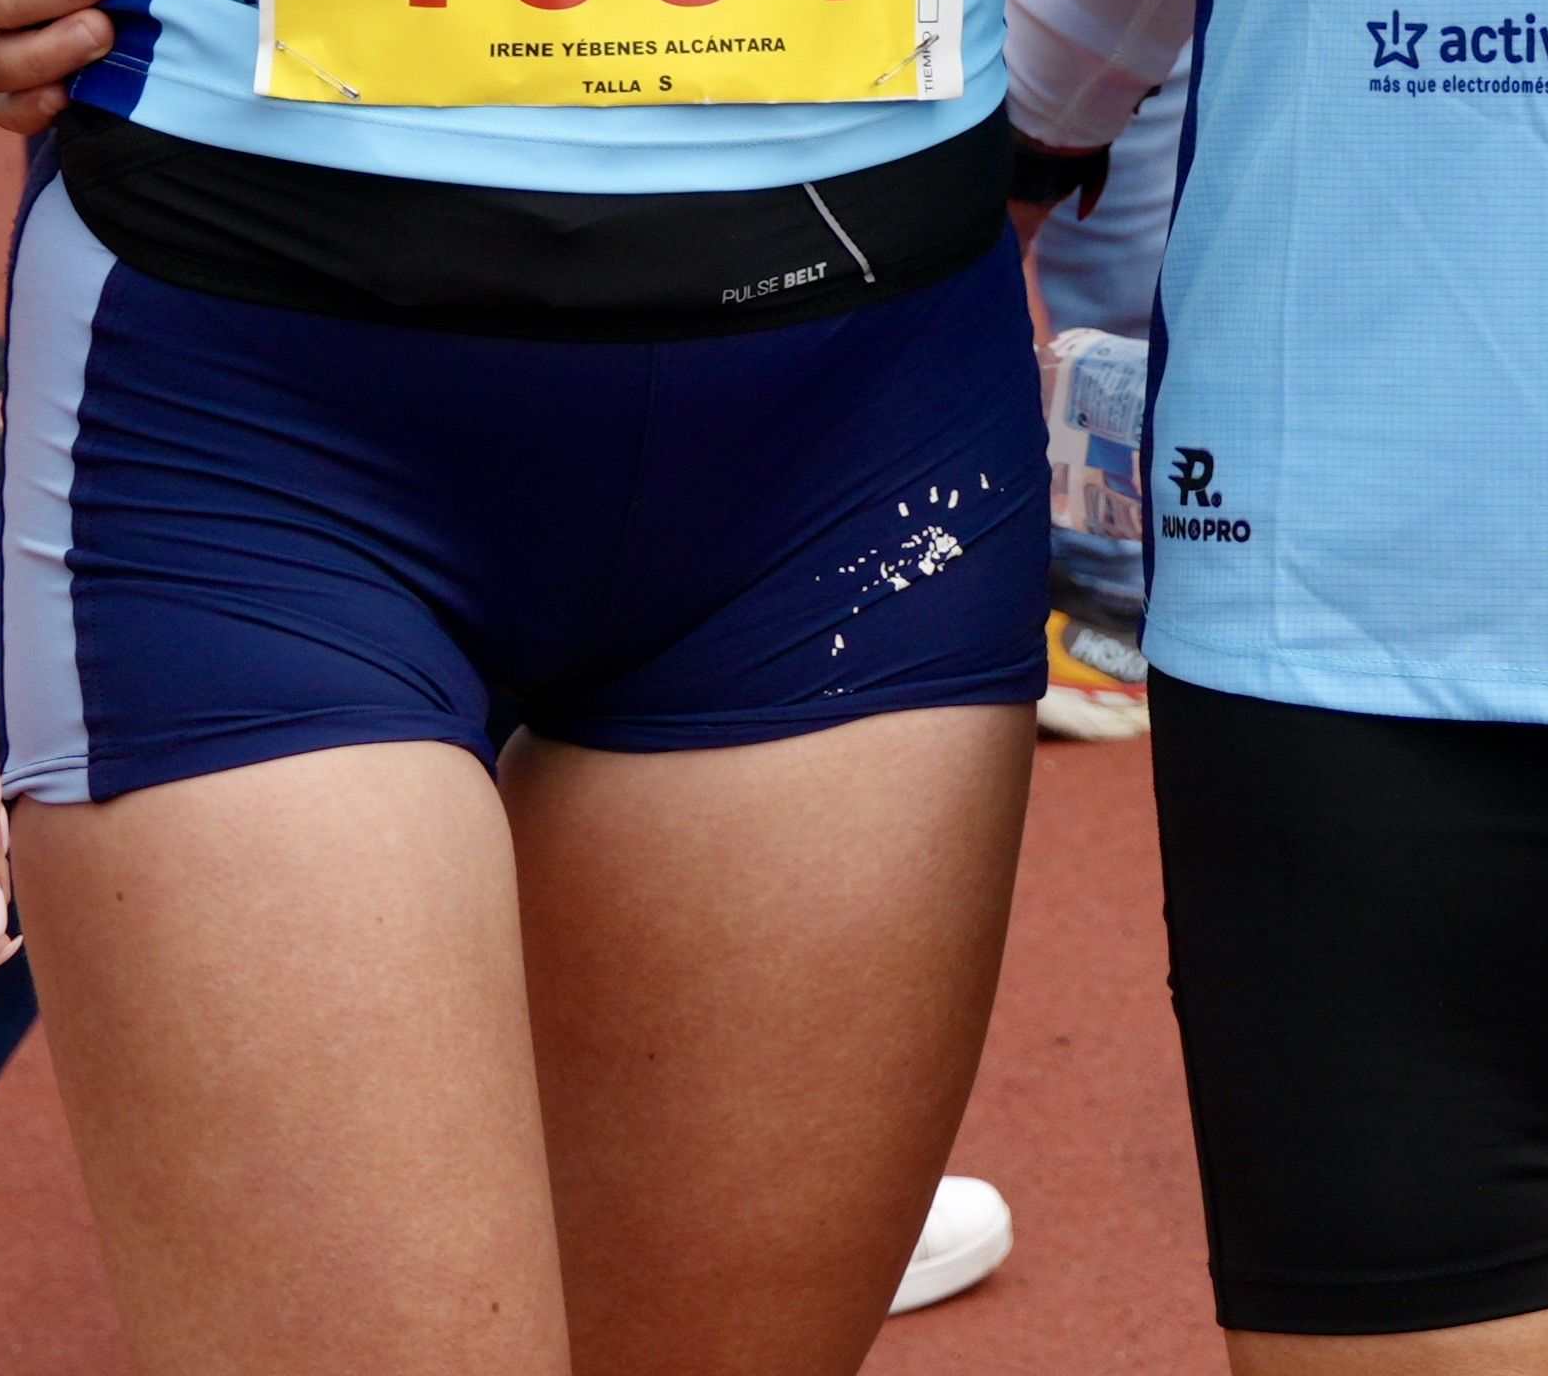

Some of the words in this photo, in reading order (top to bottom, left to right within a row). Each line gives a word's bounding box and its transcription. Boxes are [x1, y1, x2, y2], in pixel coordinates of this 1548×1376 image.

[489, 41, 554, 58] IRENE
[561, 39, 658, 58] YÉBENES
[664, 35, 787, 55] ALCÁNTARA
[582, 79, 642, 94] TALLA
[658, 74, 673, 92] S
[1368, 76, 1402, 94] más
[1405, 80, 1437, 98] que
[721, 277, 779, 304] PULSE
[783, 261, 828, 289] BELT
